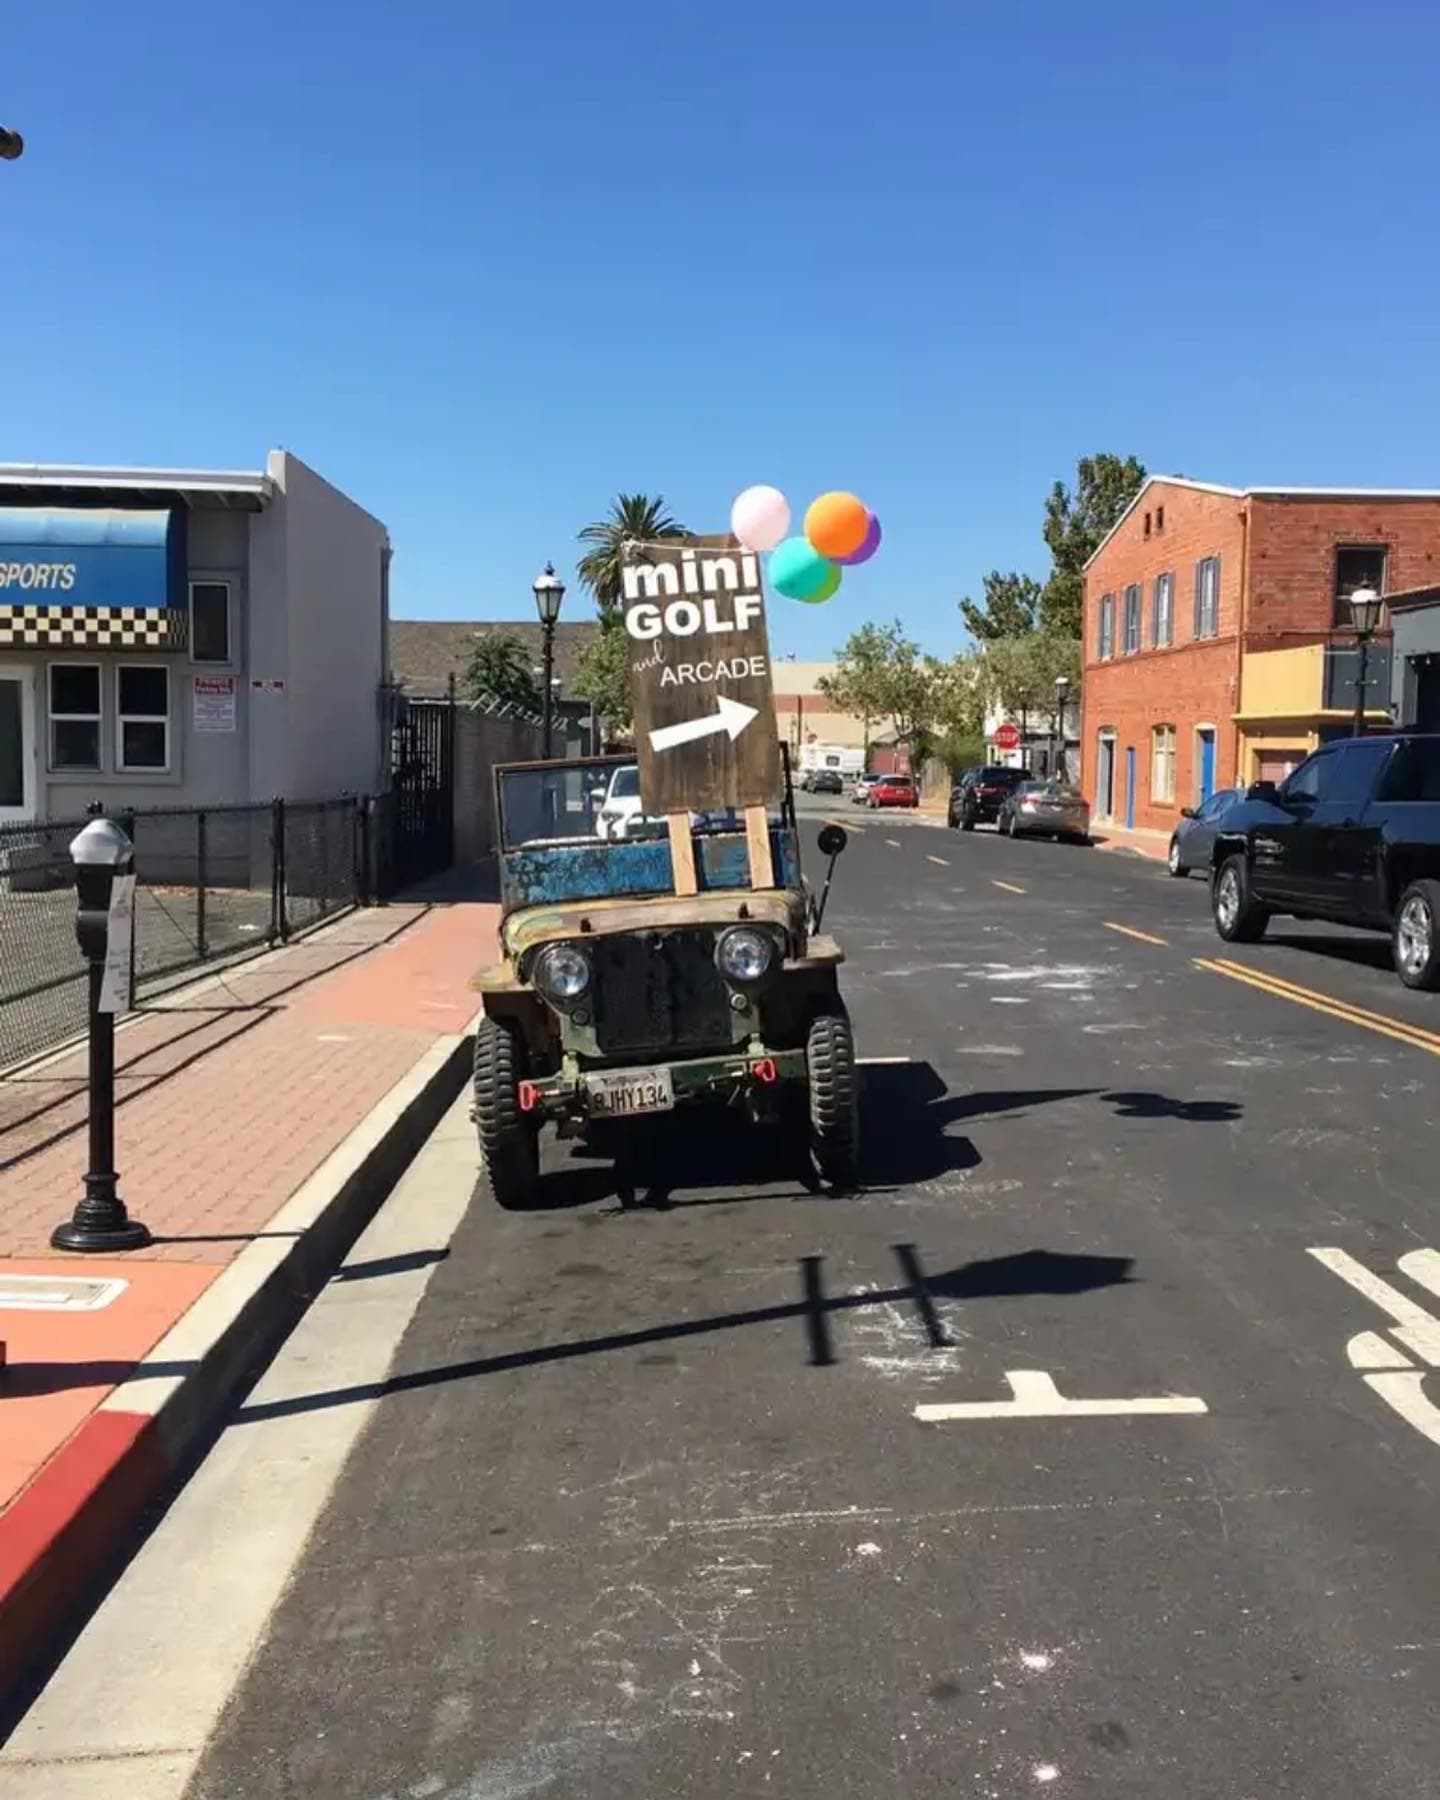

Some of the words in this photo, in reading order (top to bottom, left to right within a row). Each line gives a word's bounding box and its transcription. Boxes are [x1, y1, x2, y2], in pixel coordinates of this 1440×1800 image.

[622, 546, 758, 599] mini
[625, 594, 761, 640] GOLF
[632, 638, 666, 672] and
[660, 655, 767, 687] ARCADE
[996, 731, 1018, 743] STOP
